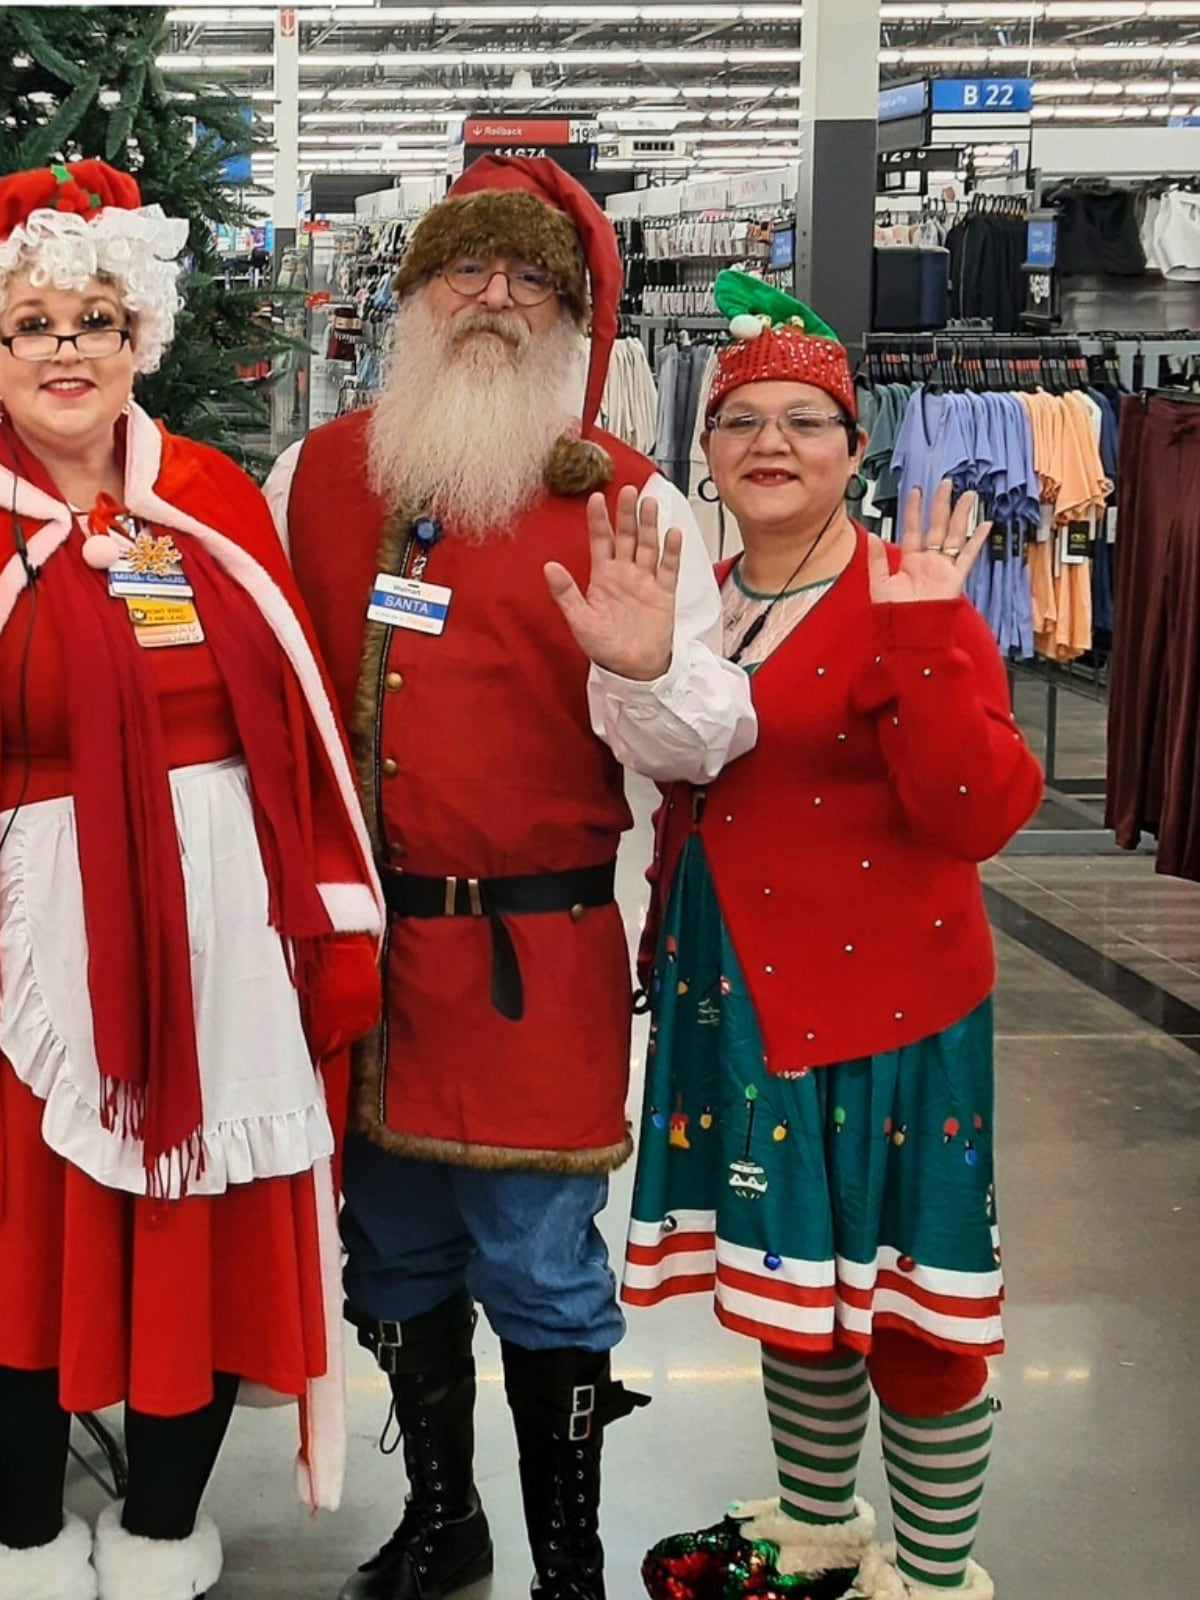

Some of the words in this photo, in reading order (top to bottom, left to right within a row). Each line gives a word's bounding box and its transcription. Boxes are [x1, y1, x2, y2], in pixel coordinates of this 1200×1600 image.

[963, 85, 979, 105] B
[985, 84, 1013, 106] 22
[483, 126, 523, 137] Rollback
[384, 594, 429, 615] SANTA
